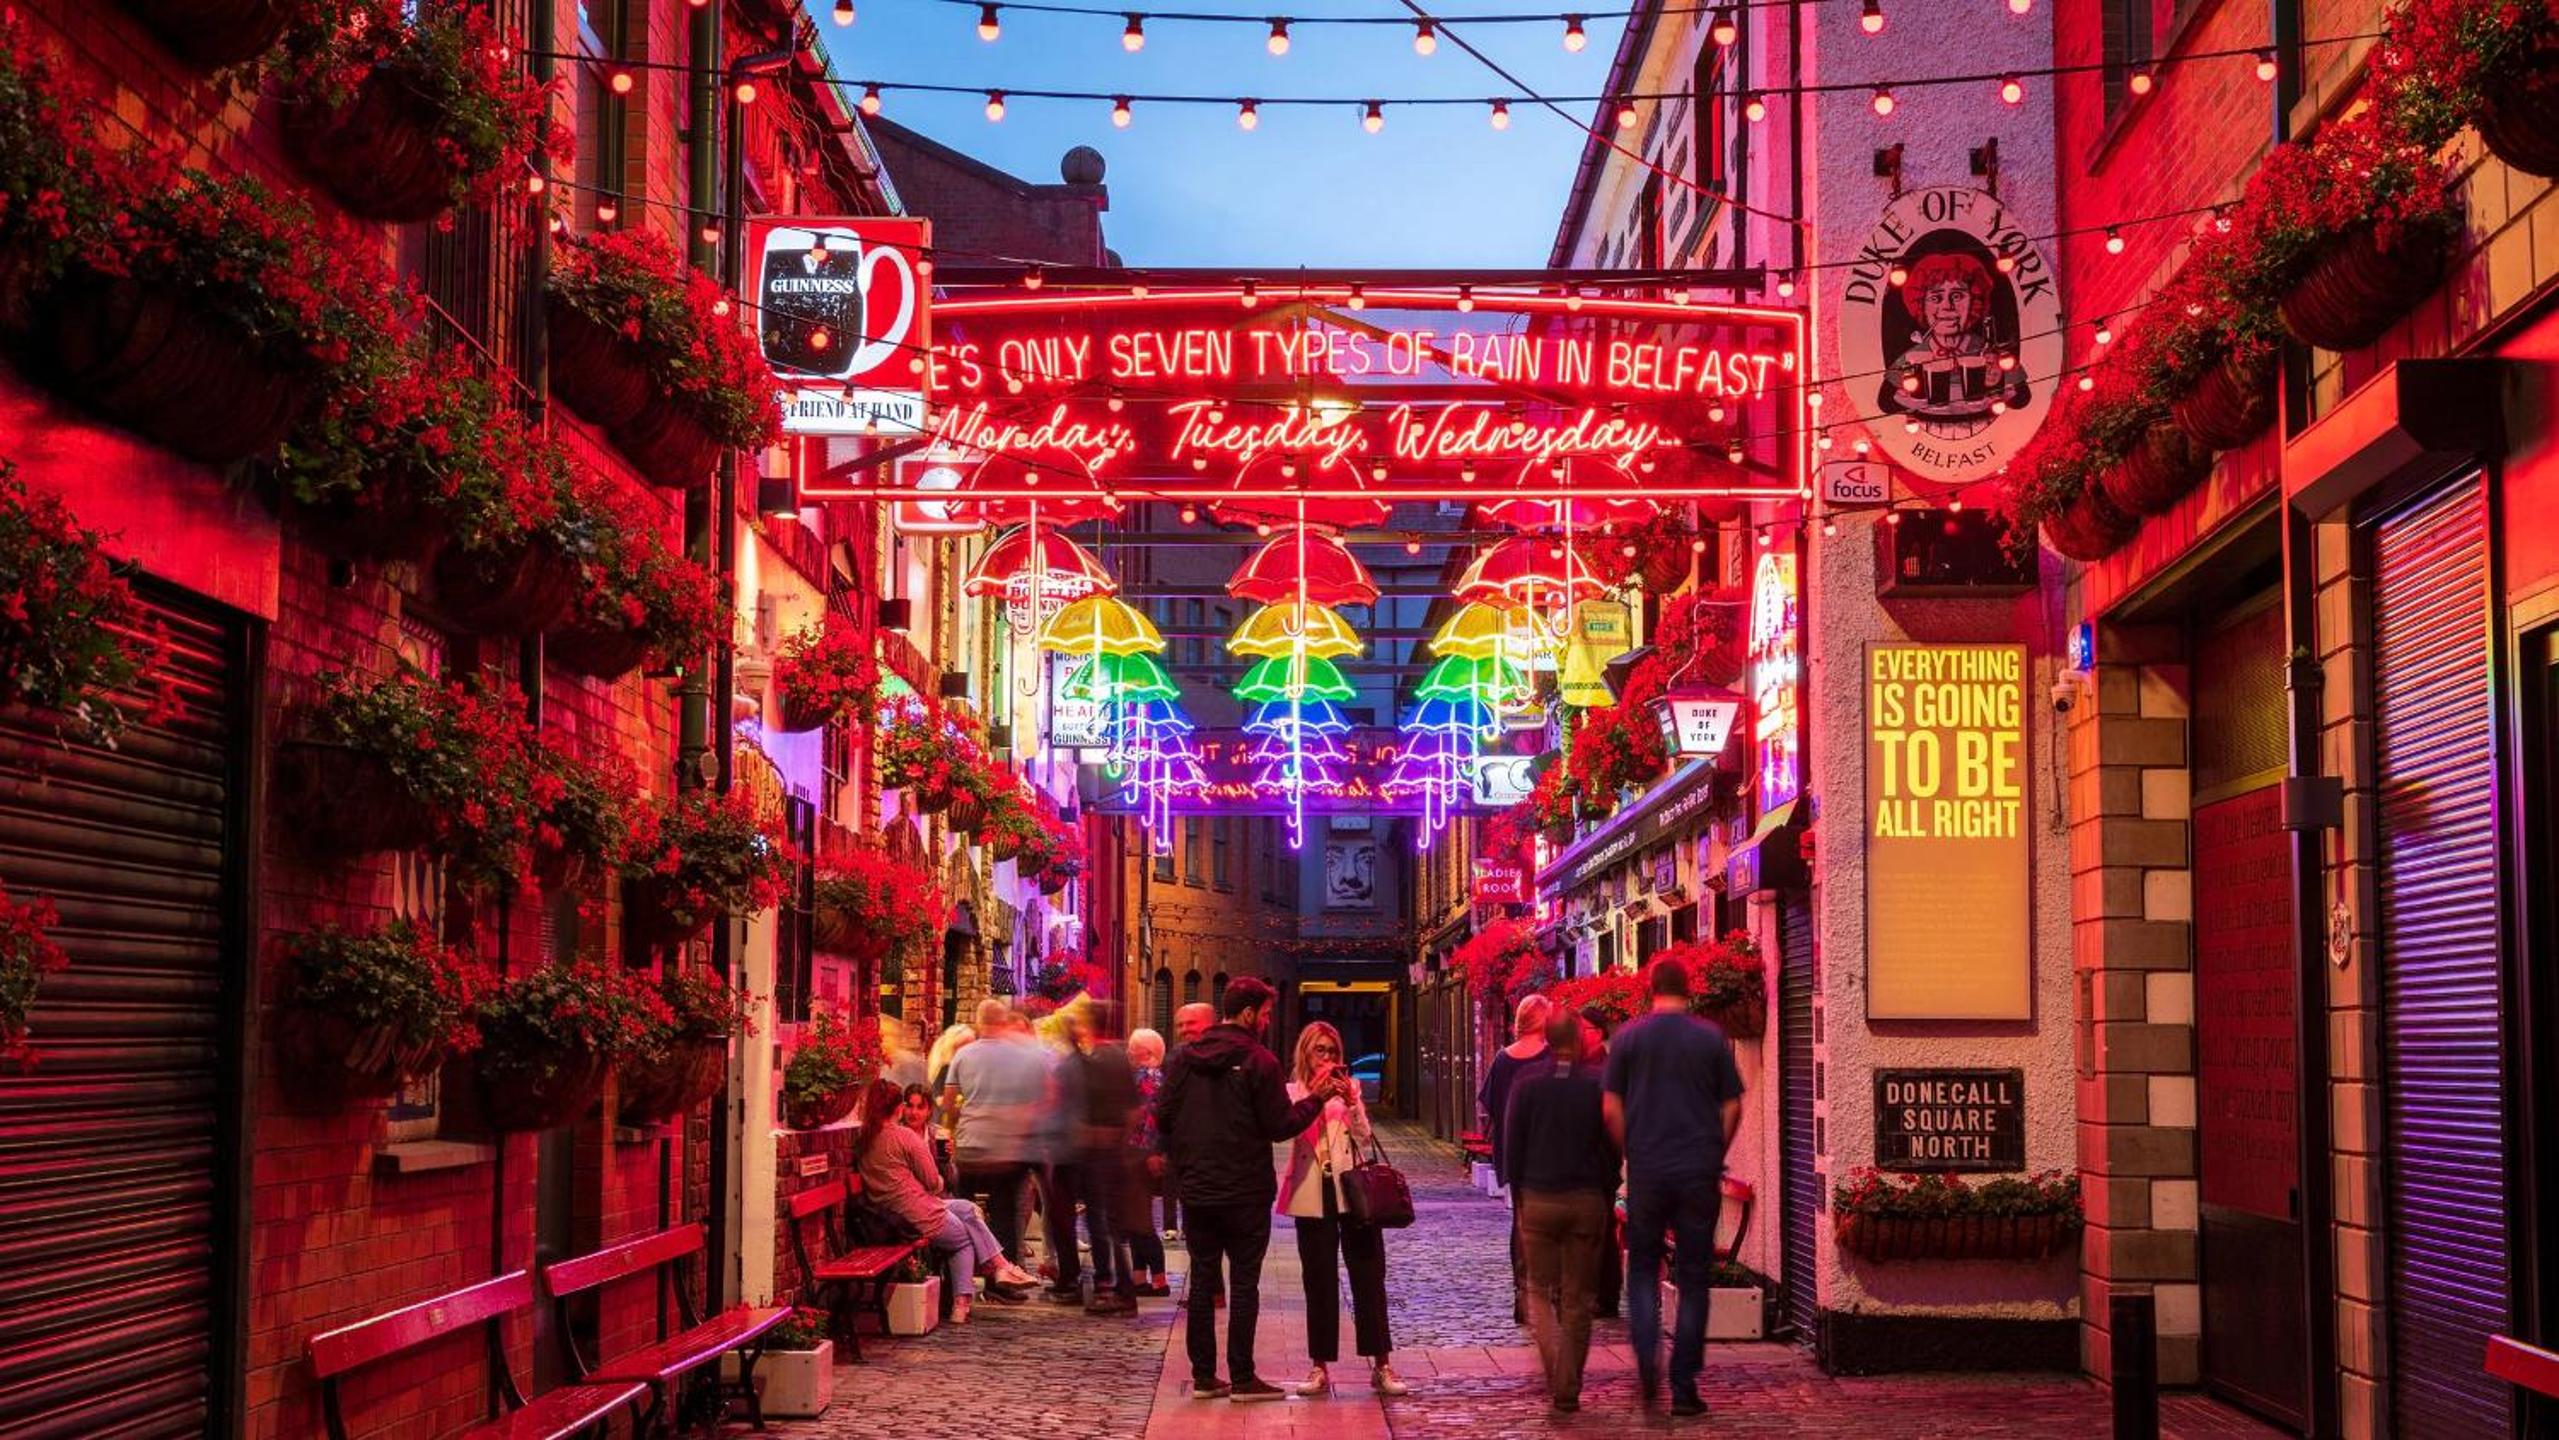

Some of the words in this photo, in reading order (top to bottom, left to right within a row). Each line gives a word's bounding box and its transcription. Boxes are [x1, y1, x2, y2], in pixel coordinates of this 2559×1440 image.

[1845, 214, 1914, 305] DUKE
[1922, 190, 1970, 222] OF
[1985, 211, 2054, 304] YORK
[770, 278, 855, 293] GUINNESS
[928, 344, 983, 392] E'S
[1000, 335, 1092, 385] ONLY
[1110, 329, 1232, 378] SEVEN
[1249, 328, 1371, 378] TYPES
[1386, 331, 1434, 375] OF
[1450, 333, 1542, 382] RAIN
[1556, 338, 1593, 384] IN
[790, 398, 845, 419] FRIEND
[870, 403, 913, 421] HAND
[1168, 400, 1368, 468] Tuesday,
[1910, 442, 1997, 468] BELFAST
[1833, 480, 1882, 498] focus
[1873, 650, 2019, 681] EVERYTHING
[1691, 708, 1718, 718] DUKE
[1874, 683, 1905, 727] IS
[1914, 683, 2019, 727] GOING
[1697, 721, 1711, 730] OF
[1874, 730, 1940, 797] TO
[1957, 731, 2020, 797] BE
[1875, 800, 1927, 837] ALL
[1934, 800, 2020, 837] RIGHT
[1887, 1082, 2012, 1105] DONECALL
[1903, 1109, 1997, 1132] SQUARE
[1911, 1136, 1991, 1158] NORTH
